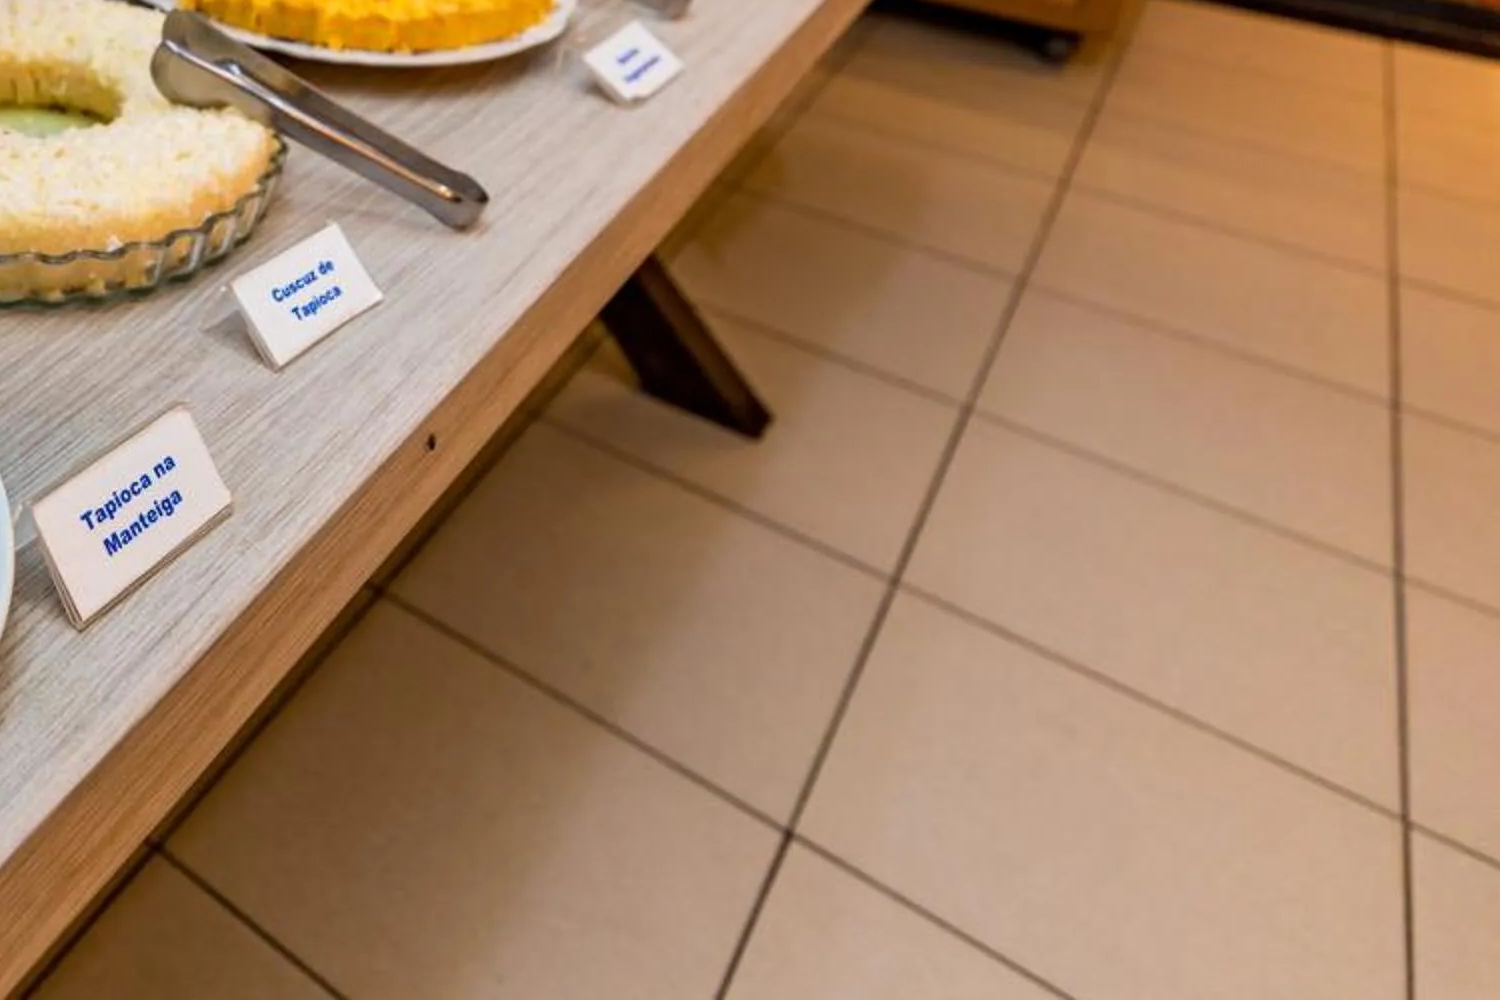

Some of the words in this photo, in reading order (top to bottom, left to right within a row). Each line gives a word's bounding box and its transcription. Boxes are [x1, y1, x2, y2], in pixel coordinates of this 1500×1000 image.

[271, 270, 318, 302] Cuscuz
[318, 260, 334, 275] de
[291, 286, 342, 320] Tapioca
[80, 474, 153, 531] Tapioca
[153, 456, 177, 479] na
[103, 489, 184, 557] Manteiga
